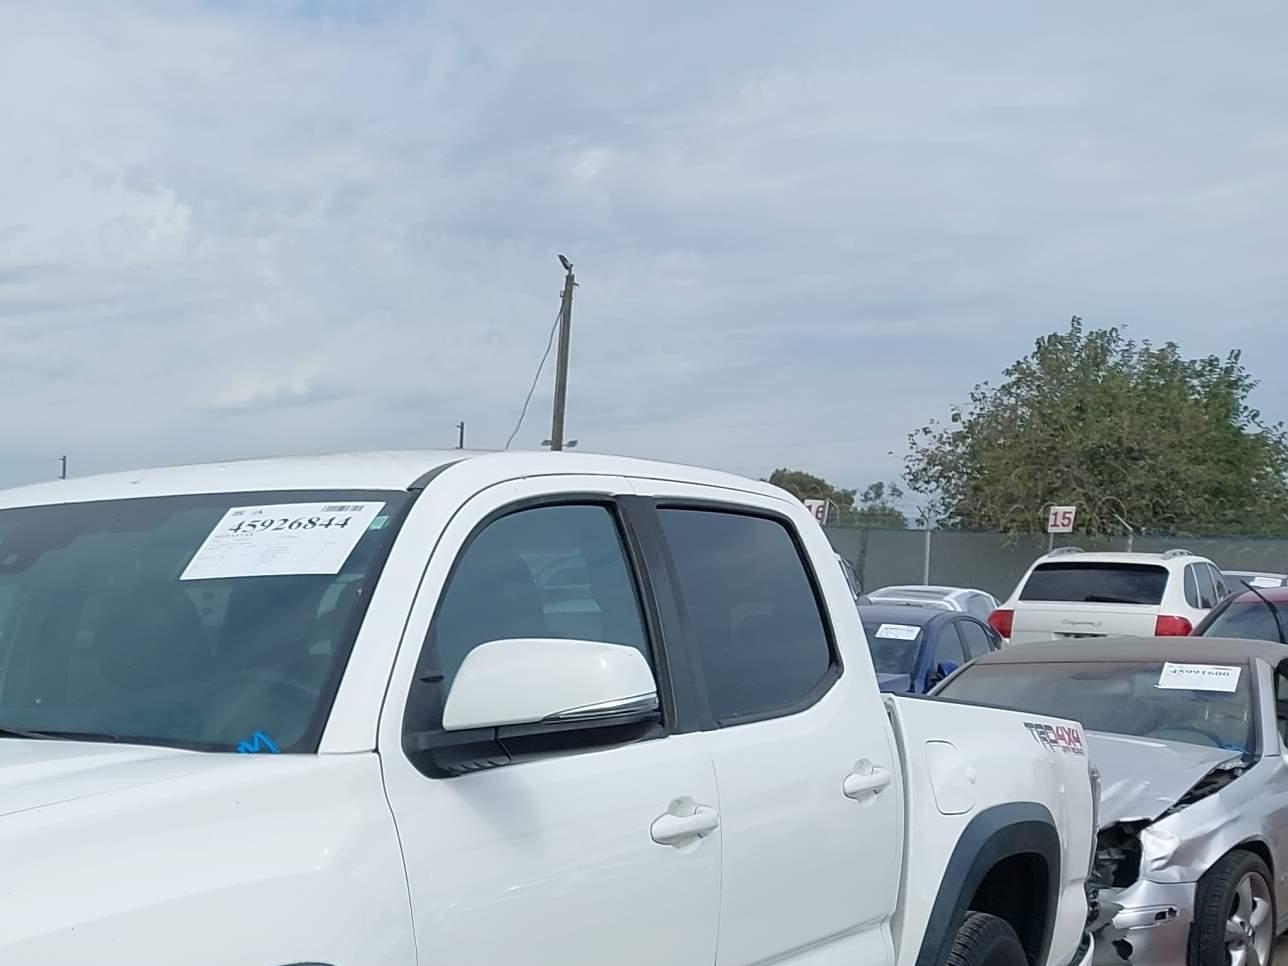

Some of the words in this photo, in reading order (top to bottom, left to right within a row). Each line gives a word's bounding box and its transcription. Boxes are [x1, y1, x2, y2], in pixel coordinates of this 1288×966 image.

[229, 515, 353, 534] 45926844
[1050, 511, 1073, 527] 15
[1023, 722, 1058, 752] TRD
